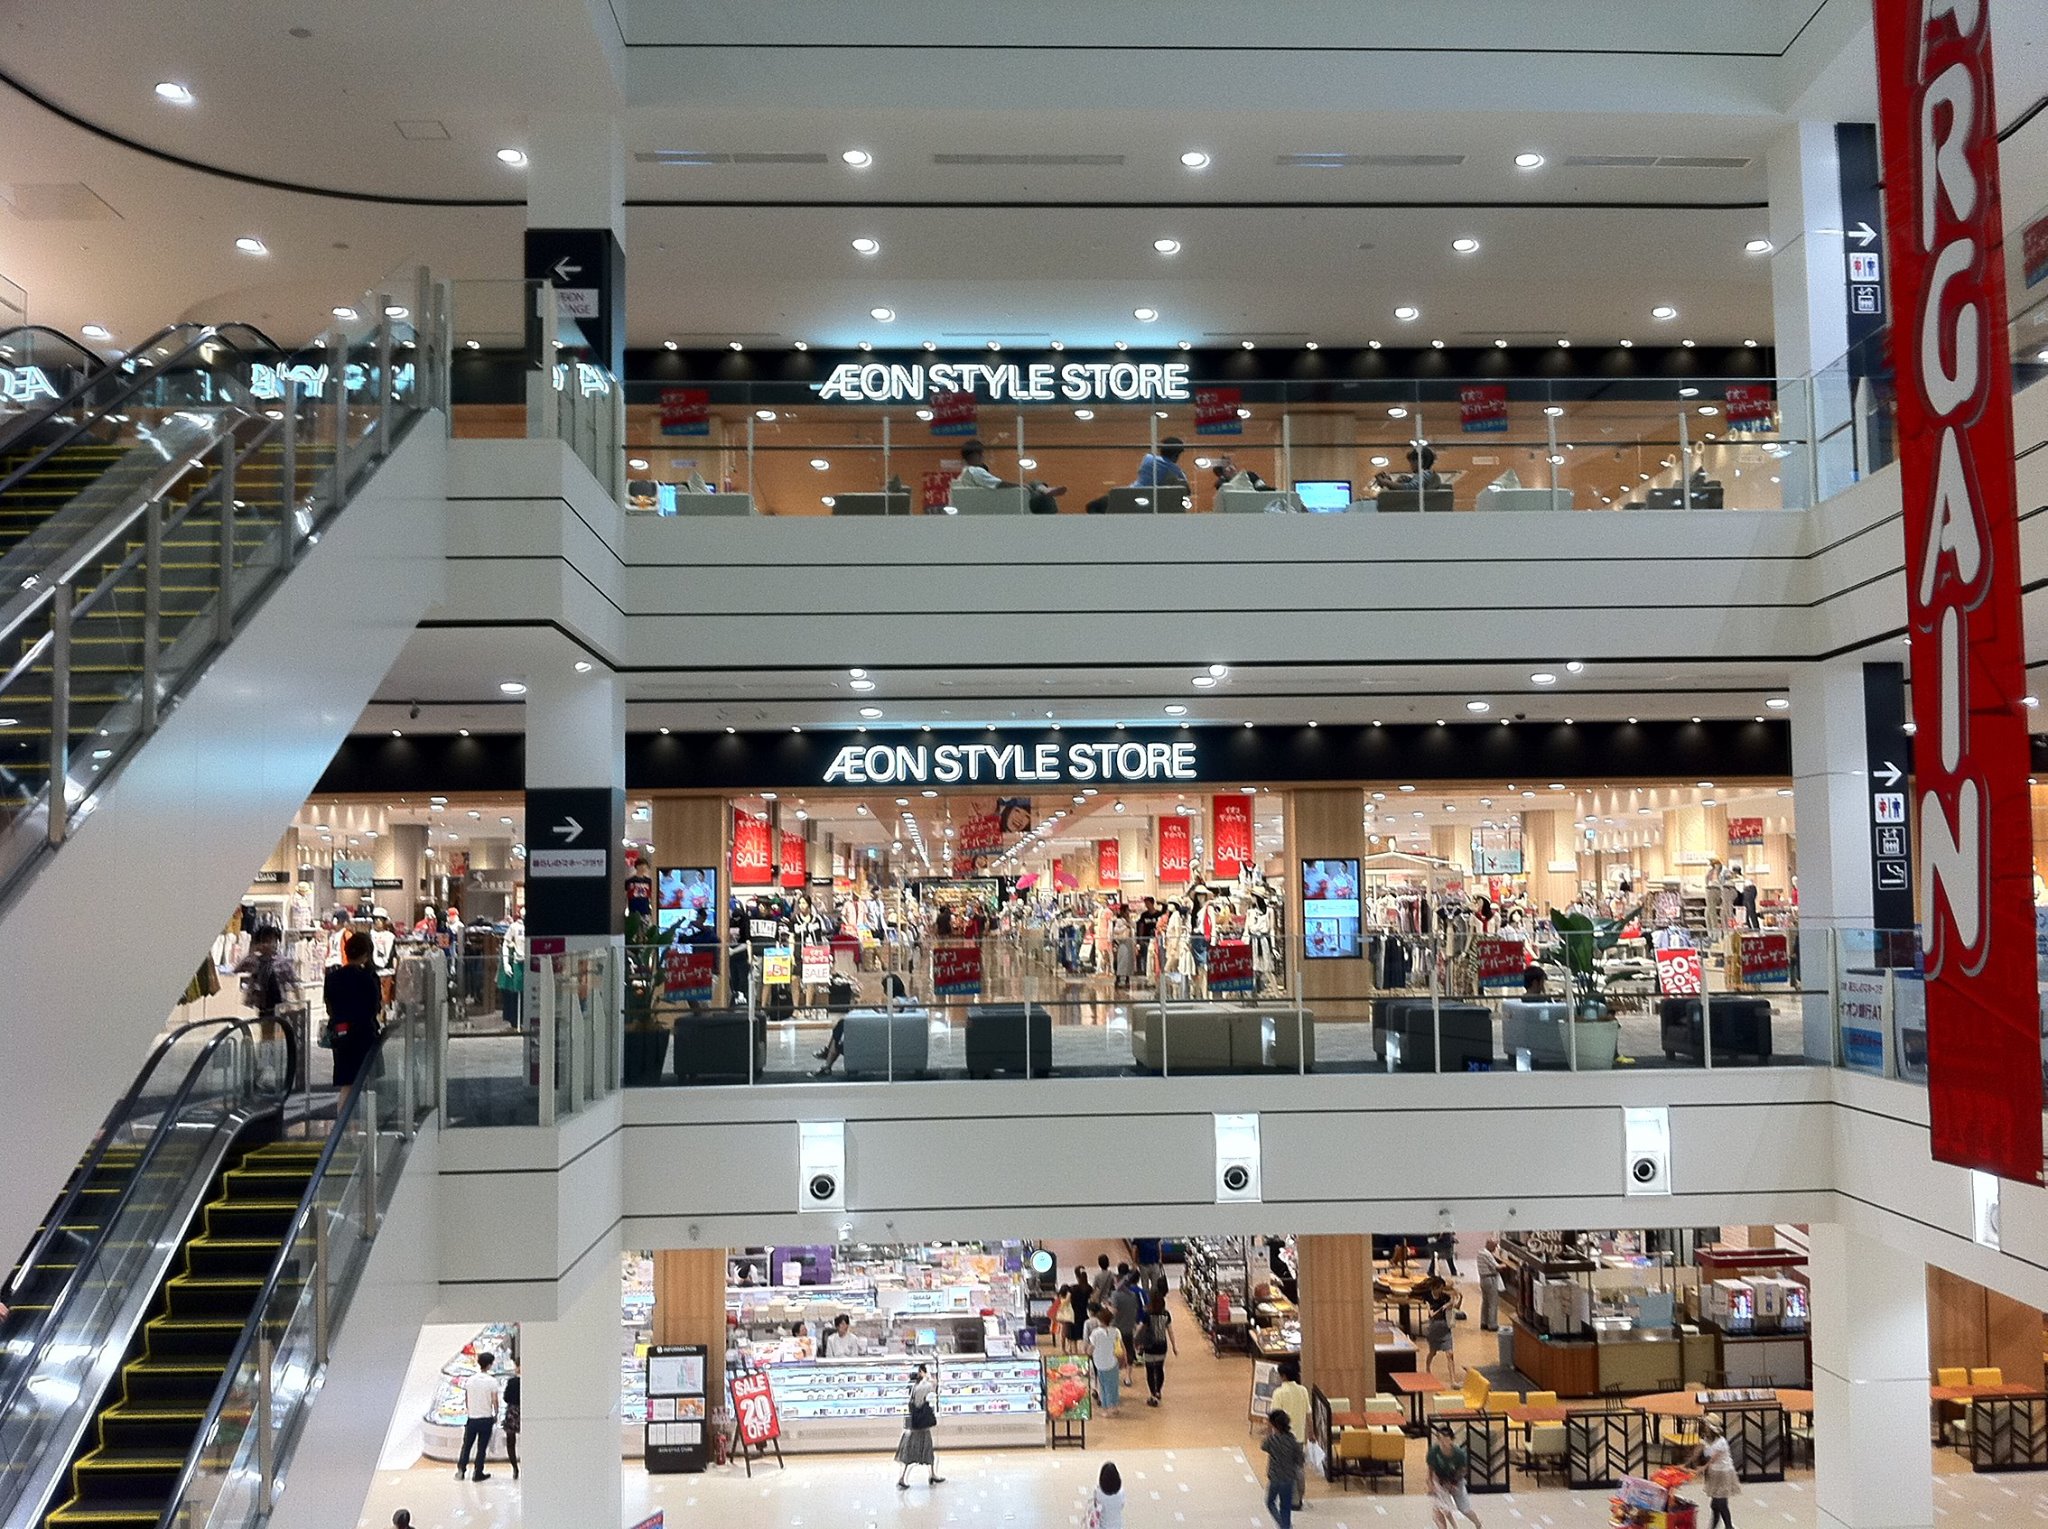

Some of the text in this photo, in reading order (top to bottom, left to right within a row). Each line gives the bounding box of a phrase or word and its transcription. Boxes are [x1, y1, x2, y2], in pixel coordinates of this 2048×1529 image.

[929, 364, 1054, 398] STYLE
[1061, 363, 1190, 399] STORE
[934, 744, 1060, 781] STYLE
[1068, 742, 1197, 779] STORE
[736, 852, 768, 868] SALE
[1217, 846, 1249, 861] SALE
[1162, 857, 1189, 870] SALE
[804, 967, 828, 979] SALE
[734, 1374, 767, 1396] SALE
[747, 1422, 772, 1439] OFF
